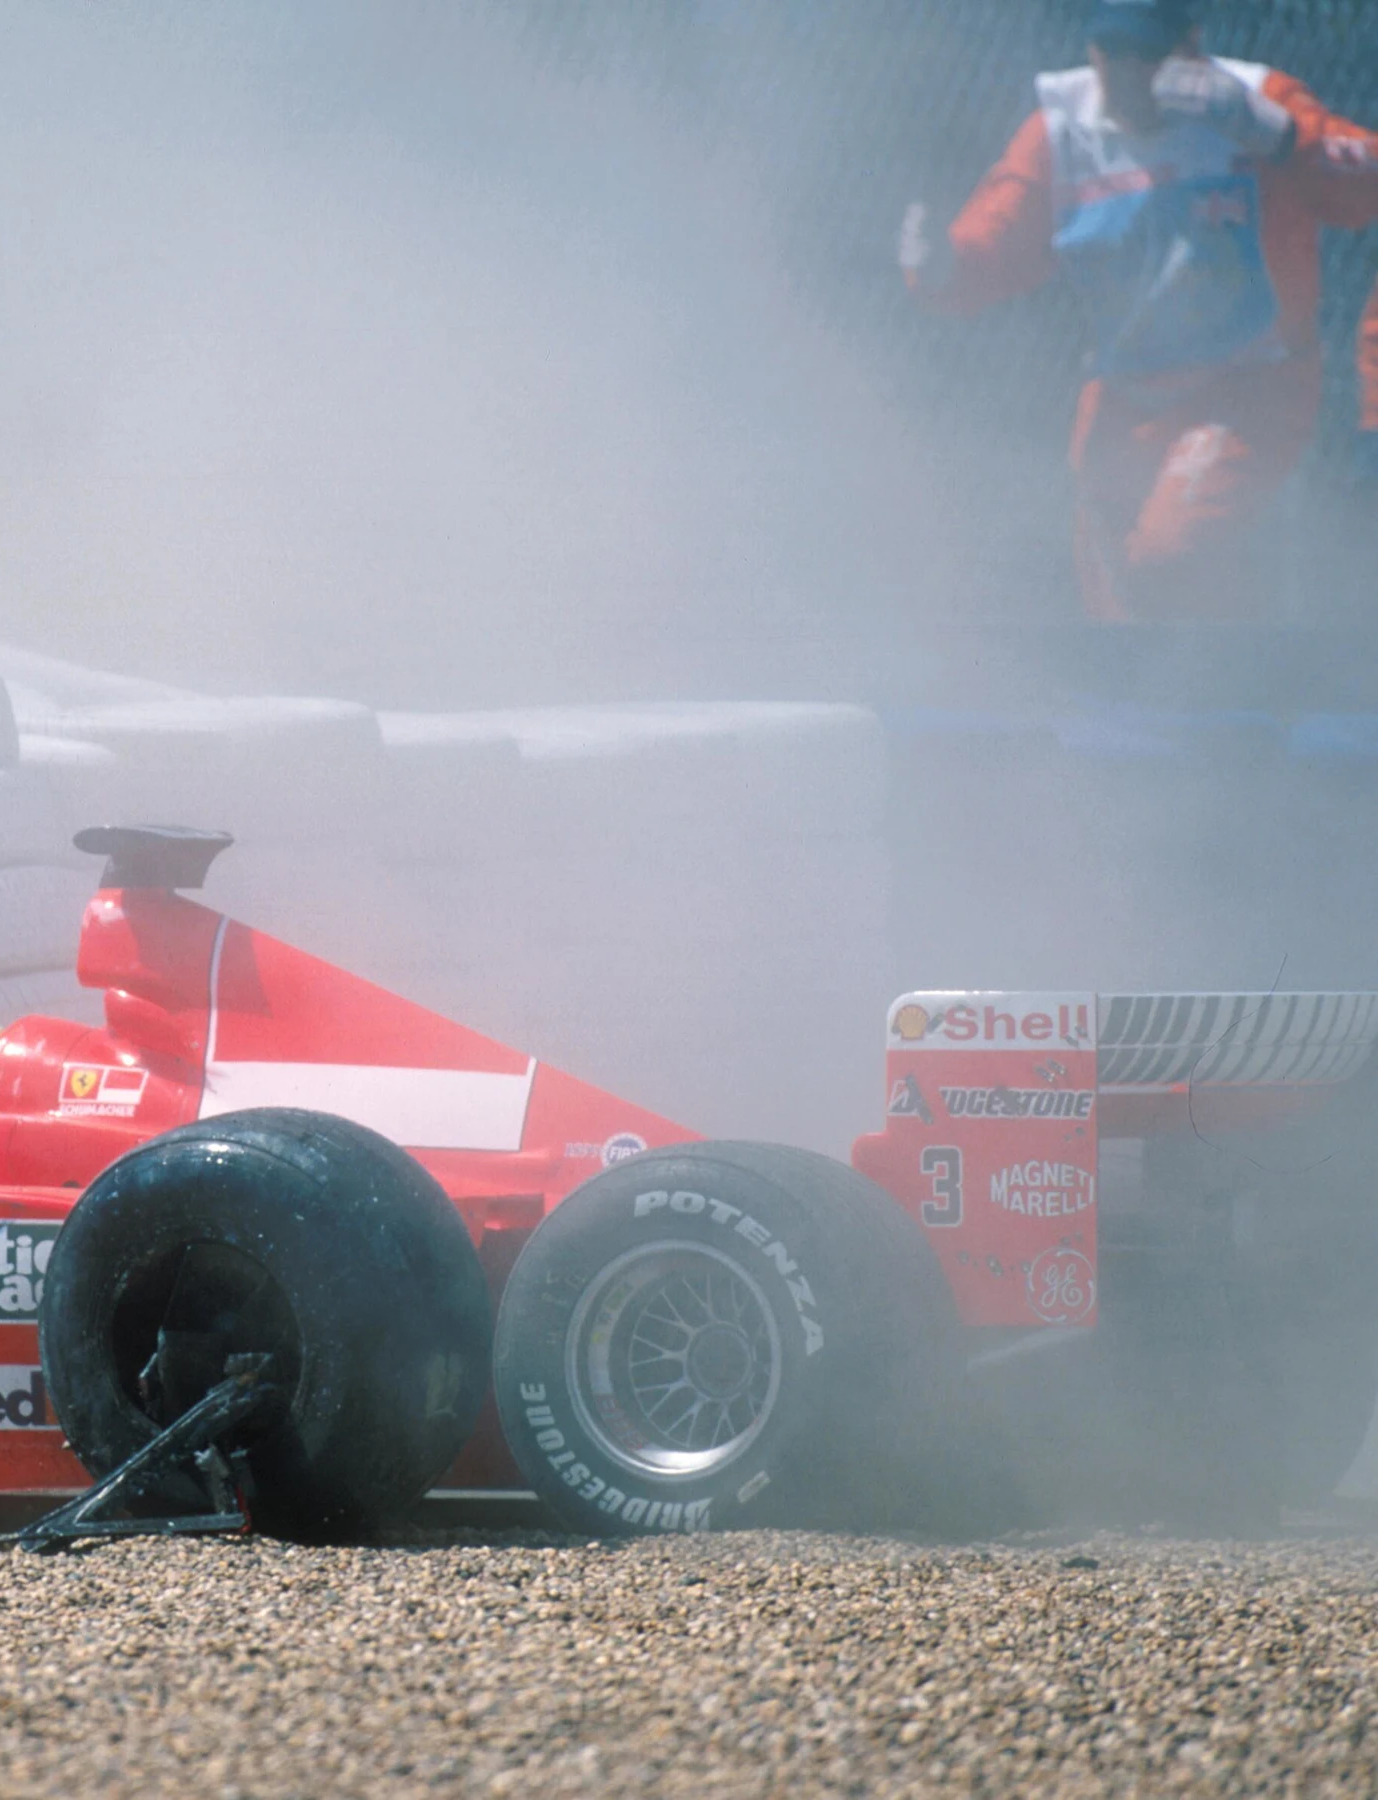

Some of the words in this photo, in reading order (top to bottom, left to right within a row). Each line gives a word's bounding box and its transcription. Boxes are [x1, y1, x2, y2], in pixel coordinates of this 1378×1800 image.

[943, 1004, 1087, 1041] Shell
[919, 1145, 963, 1227] 3
[990, 1160, 1096, 1196] MAGNETI
[990, 1183, 1096, 1218] MARELLI
[633, 1190, 824, 1356] POTENZA
[521, 1383, 713, 1532] BRIDGESTONE
